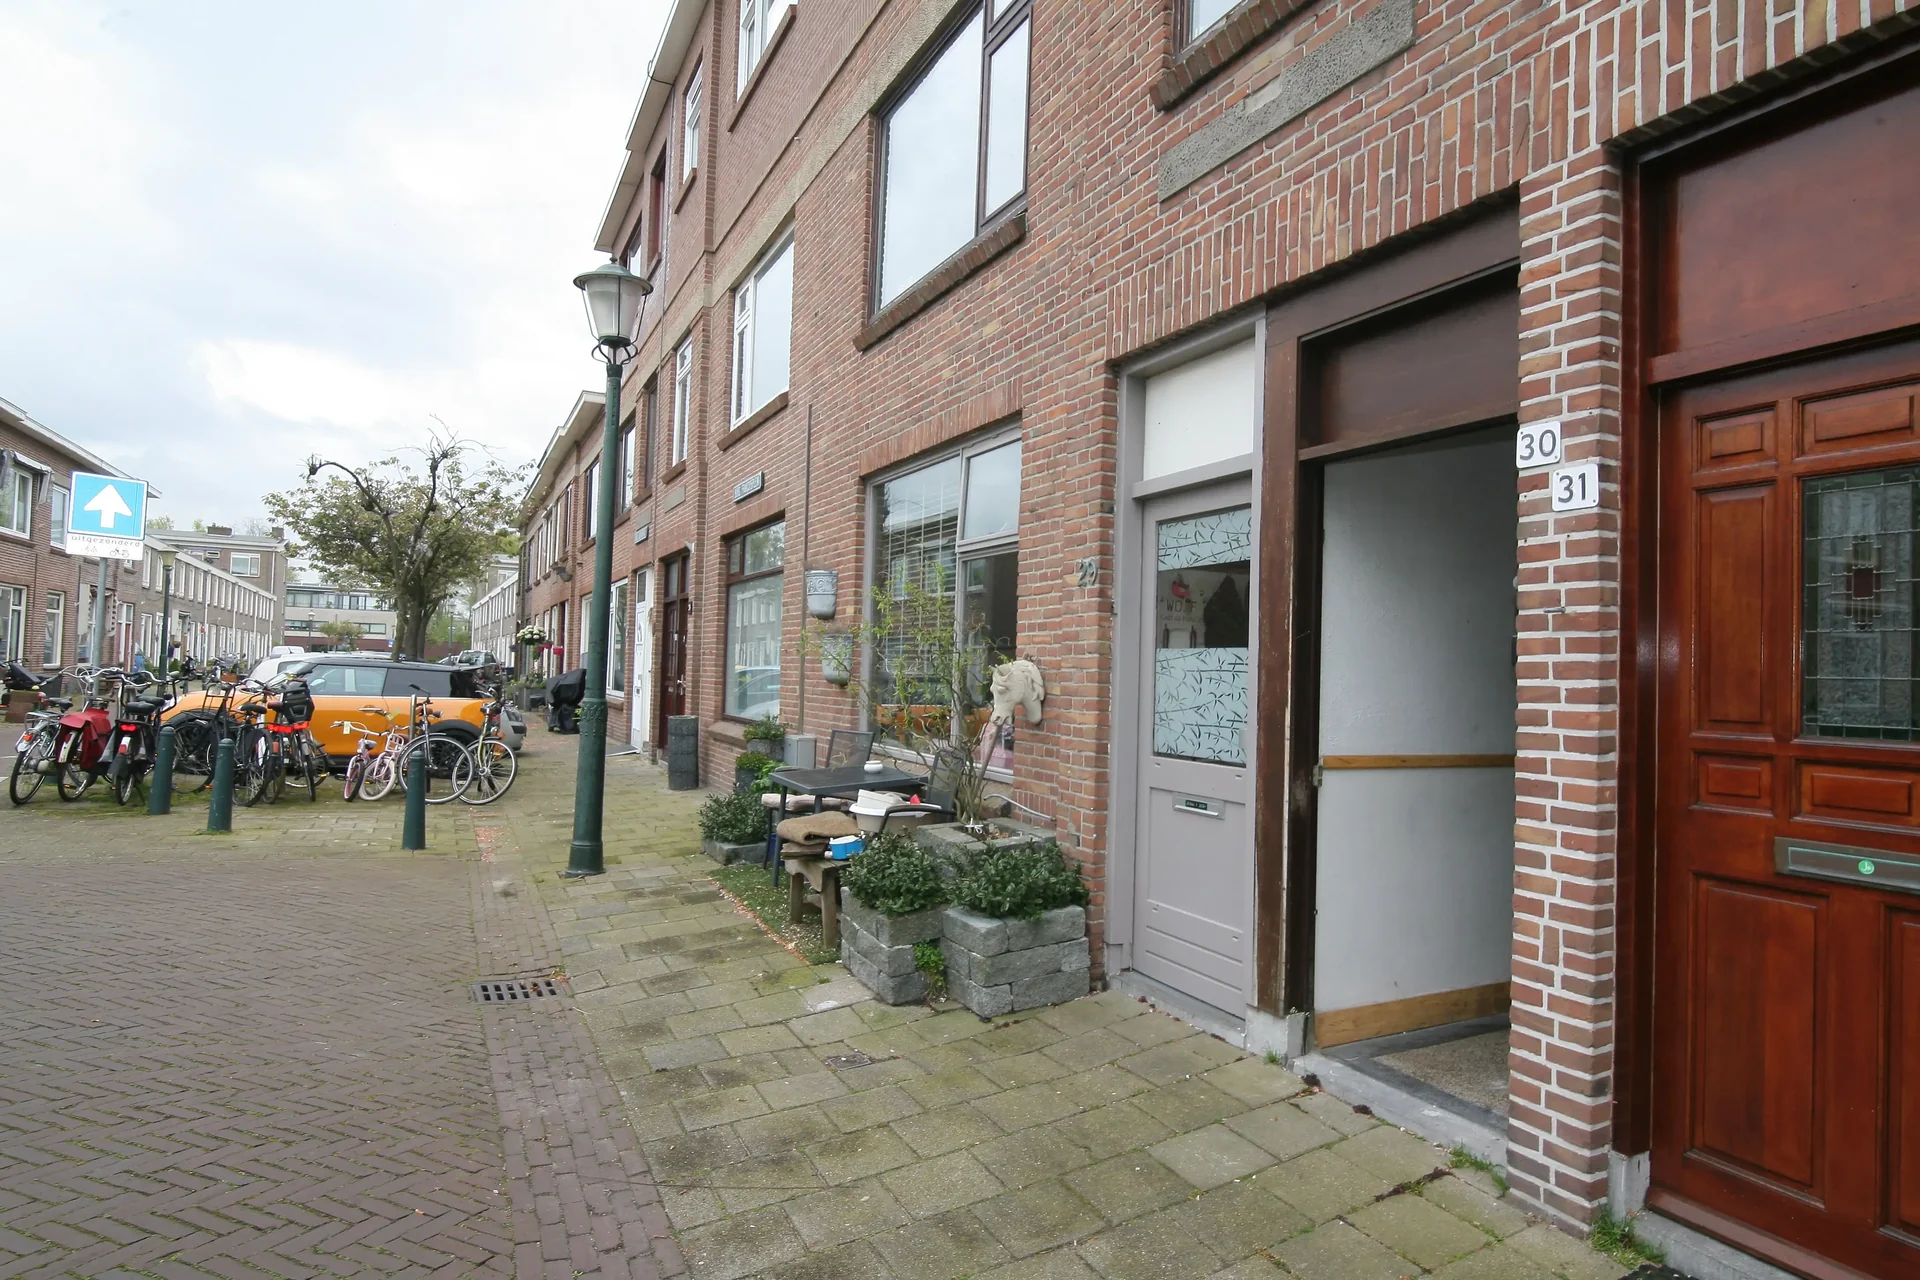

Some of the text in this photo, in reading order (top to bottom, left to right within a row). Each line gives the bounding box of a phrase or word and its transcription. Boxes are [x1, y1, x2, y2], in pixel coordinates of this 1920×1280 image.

[1520, 429, 1557, 461] 30
[1558, 472, 1586, 503] 31
[71, 535, 141, 547] uitgezonderd
[1077, 556, 1098, 587] 29
